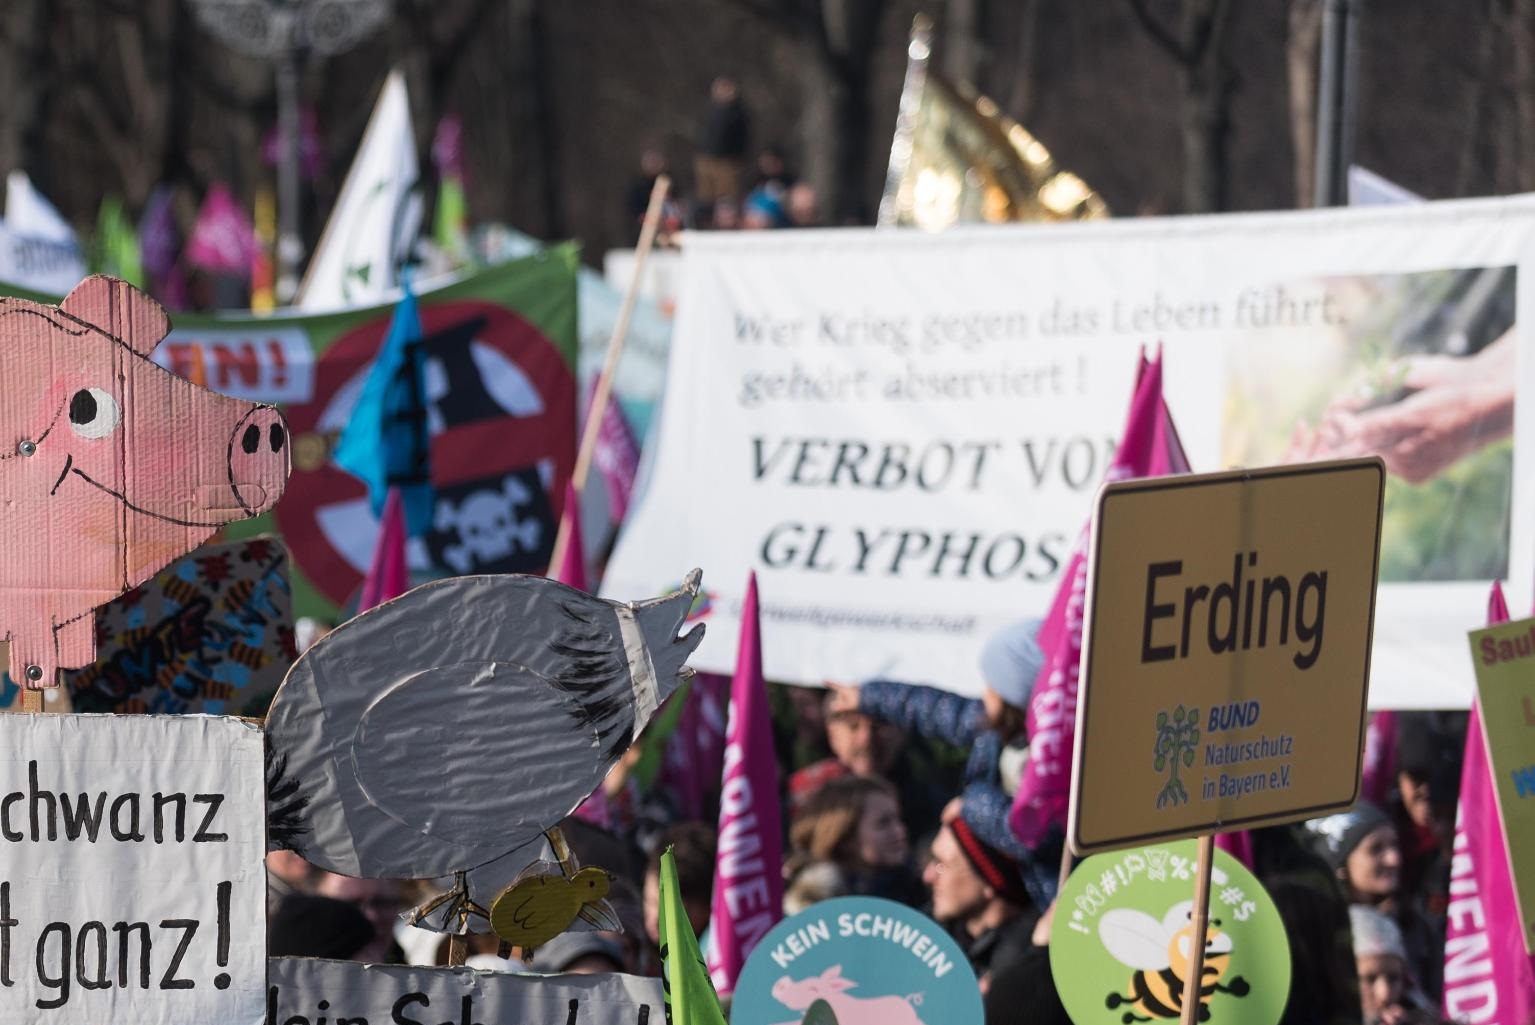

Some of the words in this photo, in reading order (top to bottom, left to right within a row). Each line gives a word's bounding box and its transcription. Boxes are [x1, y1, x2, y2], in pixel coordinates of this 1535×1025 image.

[1039, 301, 1099, 340] das
[1112, 293, 1222, 334] Leben
[750, 434, 1002, 493] VERBOT
[758, 521, 1066, 583] GLYPHOS
[1141, 551, 1329, 671] Erding
[1207, 701, 1260, 733] BUND
[1204, 735, 1293, 767] Naturschutz
[1202, 776, 1216, 799] in
[1218, 771, 1266, 801] Bayern
[1269, 765, 1292, 789] e.V.
[34, 880, 233, 1010] ganz!
[771, 918, 831, 969] KEIN
[837, 912, 954, 978] SCHWEIN
